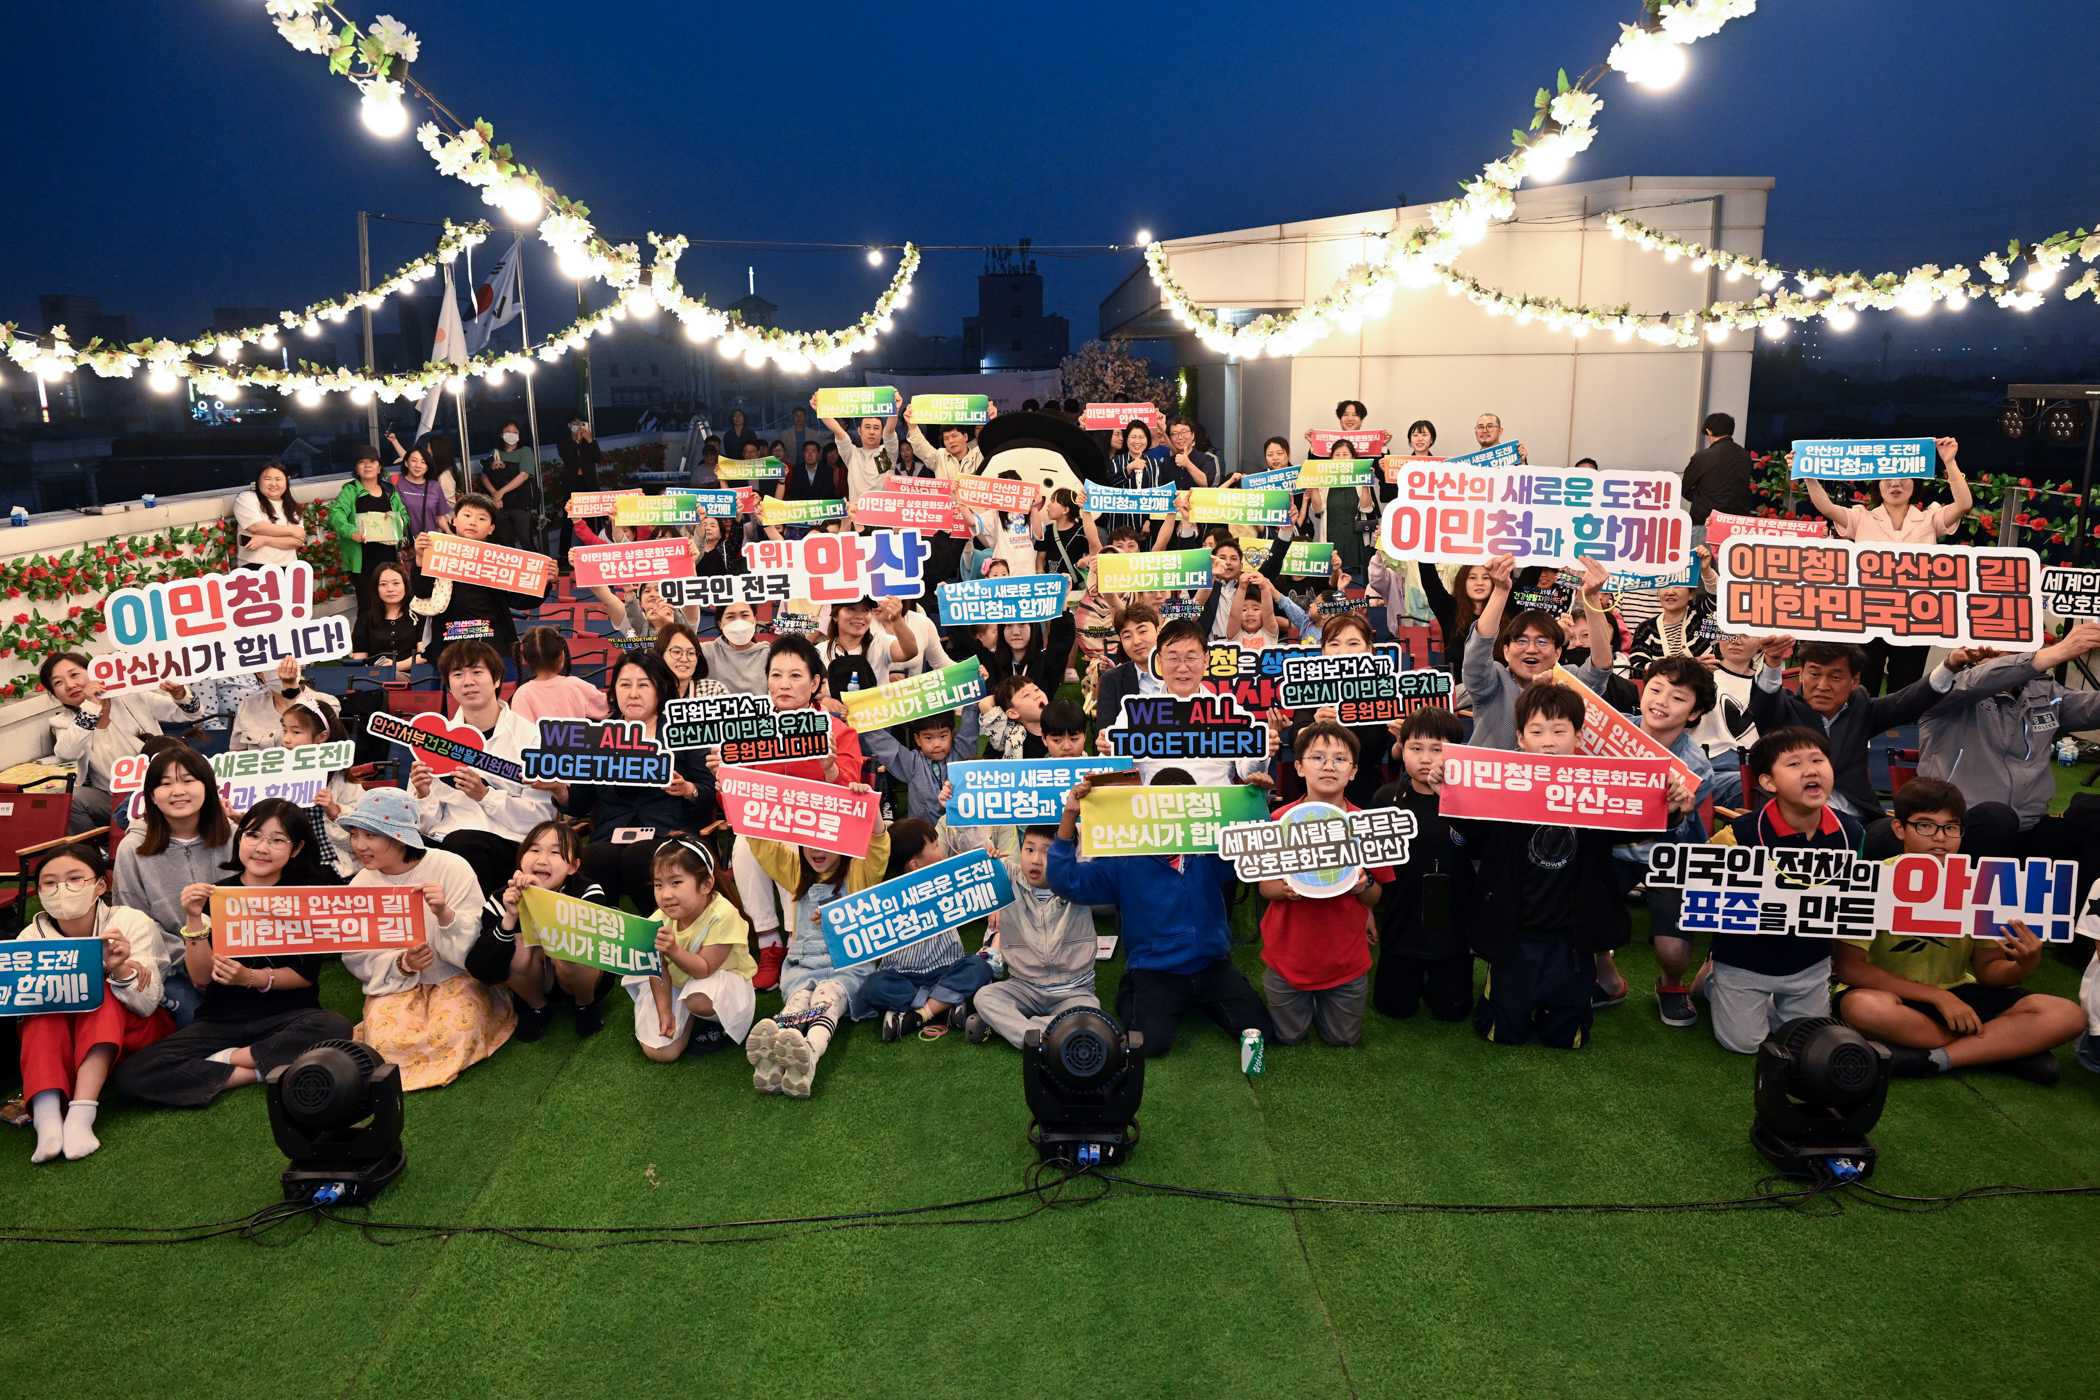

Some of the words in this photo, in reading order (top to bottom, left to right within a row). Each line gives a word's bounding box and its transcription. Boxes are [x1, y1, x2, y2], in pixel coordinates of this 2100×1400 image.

[837, 390, 875, 402] 이민청!
[931, 397, 969, 410] 이민청!
[820, 404, 860, 415] 안산시가
[861, 403, 894, 414] 합니다!
[914, 411, 953, 422] 안산시가
[955, 410, 987, 422] 합니다!
[1086, 407, 1120, 419] 이민청은
[1805, 445, 1844, 456] 안산의
[1846, 444, 1886, 456] 새로운
[1889, 443, 1920, 455] 도전!
[720, 468, 754, 478] 안산시가
[755, 467, 782, 477] 합니다!
[1317, 462, 1354, 474] 이민청!
[1799, 457, 1874, 475] 이민청과
[1877, 456, 1926, 474] 함께!
[958, 478, 990, 492] 이민청!
[992, 482, 1020, 495] 안산의
[1022, 486, 1035, 497] 길!
[1299, 475, 1338, 486] 안산시가
[1339, 473, 1372, 485] 합니다!
[1406, 470, 1495, 503] 안산의
[1500, 474, 1594, 508] 새로운
[1600, 478, 1672, 510] 도전!
[573, 494, 600, 504] 이민청!
[637, 497, 677, 511] 이민청!
[706, 504, 731, 515] 함께!
[716, 494, 734, 503] 도전!
[858, 497, 904, 512] 이민청은
[958, 488, 1016, 509] 대한민국의
[1090, 496, 1138, 511] 이민청과
[1139, 496, 1169, 511] 함께!
[1217, 491, 1265, 507] 이민청!
[619, 511, 661, 524] 안산시가
[662, 510, 697, 522] 합니다!
[765, 508, 808, 523] 안산시가
[809, 504, 844, 517] 합니다!
[901, 508, 943, 523] 안산으로
[1194, 506, 1244, 522] 안산시가
[1246, 508, 1288, 523] 합니다!
[1757, 519, 1818, 533] 상호문화도시
[1390, 506, 1565, 558] 이민청과
[1572, 512, 1682, 564] 함께!
[433, 539, 480, 560] 이민청!
[482, 549, 524, 569] 안산의
[526, 558, 544, 573] 길!
[581, 550, 622, 563] 이민청은
[624, 545, 685, 560] 상호문화도시
[741, 543, 794, 570] 1위!
[803, 528, 927, 602] 안산
[1128, 553, 1182, 571] 이민청!
[1291, 559, 1329, 574] 합니다!
[429, 554, 516, 586] 대한민국의
[518, 572, 541, 590] 길!
[599, 557, 671, 580] 안산으로
[1104, 573, 1160, 588] 안산시가
[1162, 570, 1207, 587] 합니다!
[1729, 545, 1847, 584] 이민청!
[1858, 551, 1968, 590] 안산의
[1977, 558, 2028, 592] 길!
[661, 576, 733, 608] 외국인
[741, 574, 791, 602] 전국
[944, 581, 993, 602] 안산의
[993, 583, 1032, 598] 새로운
[1033, 580, 1062, 596] 도전!
[2043, 572, 2100, 593] 세계의
[111, 566, 306, 646] 이민청!
[949, 599, 1017, 620] 이민청과
[1017, 596, 1058, 619] 함께!
[1729, 582, 1957, 637] 대한민국의
[1969, 596, 2031, 641] 길!
[94, 641, 227, 692] 안산시가
[233, 621, 346, 668] 합니다!
[1288, 658, 1390, 681] 단원보건소가
[881, 667, 946, 701] 이민청!
[1285, 682, 1338, 705] 안산시
[1342, 677, 1395, 700] 이민청
[1400, 672, 1450, 696] 유치를
[670, 697, 770, 723] 단원보건소가
[854, 695, 924, 729] 안산시가
[923, 678, 981, 710] 합니다!
[1129, 701, 1180, 727] WE,
[1189, 699, 1248, 726] ALL,
[667, 722, 719, 746] 안산시
[724, 717, 775, 741] 이민청
[778, 713, 829, 735] 유치를
[2033, 722, 2056, 730] POLICE
[599, 727, 655, 752] ALL,
[721, 736, 828, 761] 응원합니다!!!
[1112, 730, 1263, 756] TOGETHER!
[214, 749, 286, 779] 새로운
[292, 743, 351, 772] 도전!
[524, 751, 668, 781] TOGETHER!
[964, 769, 1015, 790] 안산의
[1018, 767, 1071, 788] 새로운
[1444, 758, 1552, 792] 이민청은
[1556, 766, 1666, 790] 상호문화도시
[722, 776, 779, 804] 이민청은
[781, 788, 867, 819] 상호문화도시
[957, 790, 1058, 819] 이민청과
[1130, 790, 1222, 820] 이민청!
[1545, 784, 1644, 816] 안산으로
[743, 799, 842, 842] 안산으로
[1225, 827, 1283, 854] 세계의
[1289, 819, 1346, 846] 사람을
[1351, 811, 1412, 838] 부르는
[1091, 824, 1185, 850] 안산시가
[1241, 838, 1358, 876] 상호문화도시
[1363, 836, 1407, 863] 안산
[1540, 859, 1567, 867] POWER
[1650, 845, 1764, 889] 외국인
[1774, 848, 1880, 893] 정책의
[225, 895, 300, 918] 이민청!
[308, 894, 375, 916] 안산의
[381, 894, 410, 915] 길!
[828, 891, 900, 935] 안산의
[901, 877, 953, 907] 새로운
[953, 859, 996, 888] 도전!
[1891, 855, 2074, 943] 안산!
[555, 899, 626, 941] 이민청!
[843, 910, 939, 959] 이민청과
[937, 882, 999, 924] 함께!
[1682, 890, 1787, 932] 표준을
[1797, 895, 1876, 937] 만든
[225, 917, 369, 947] 대한민국의
[377, 919, 413, 949] 길!
[36, 949, 78, 972] 도전!
[598, 940, 663, 973] 합니다!
[14, 973, 89, 1006] 함께!
